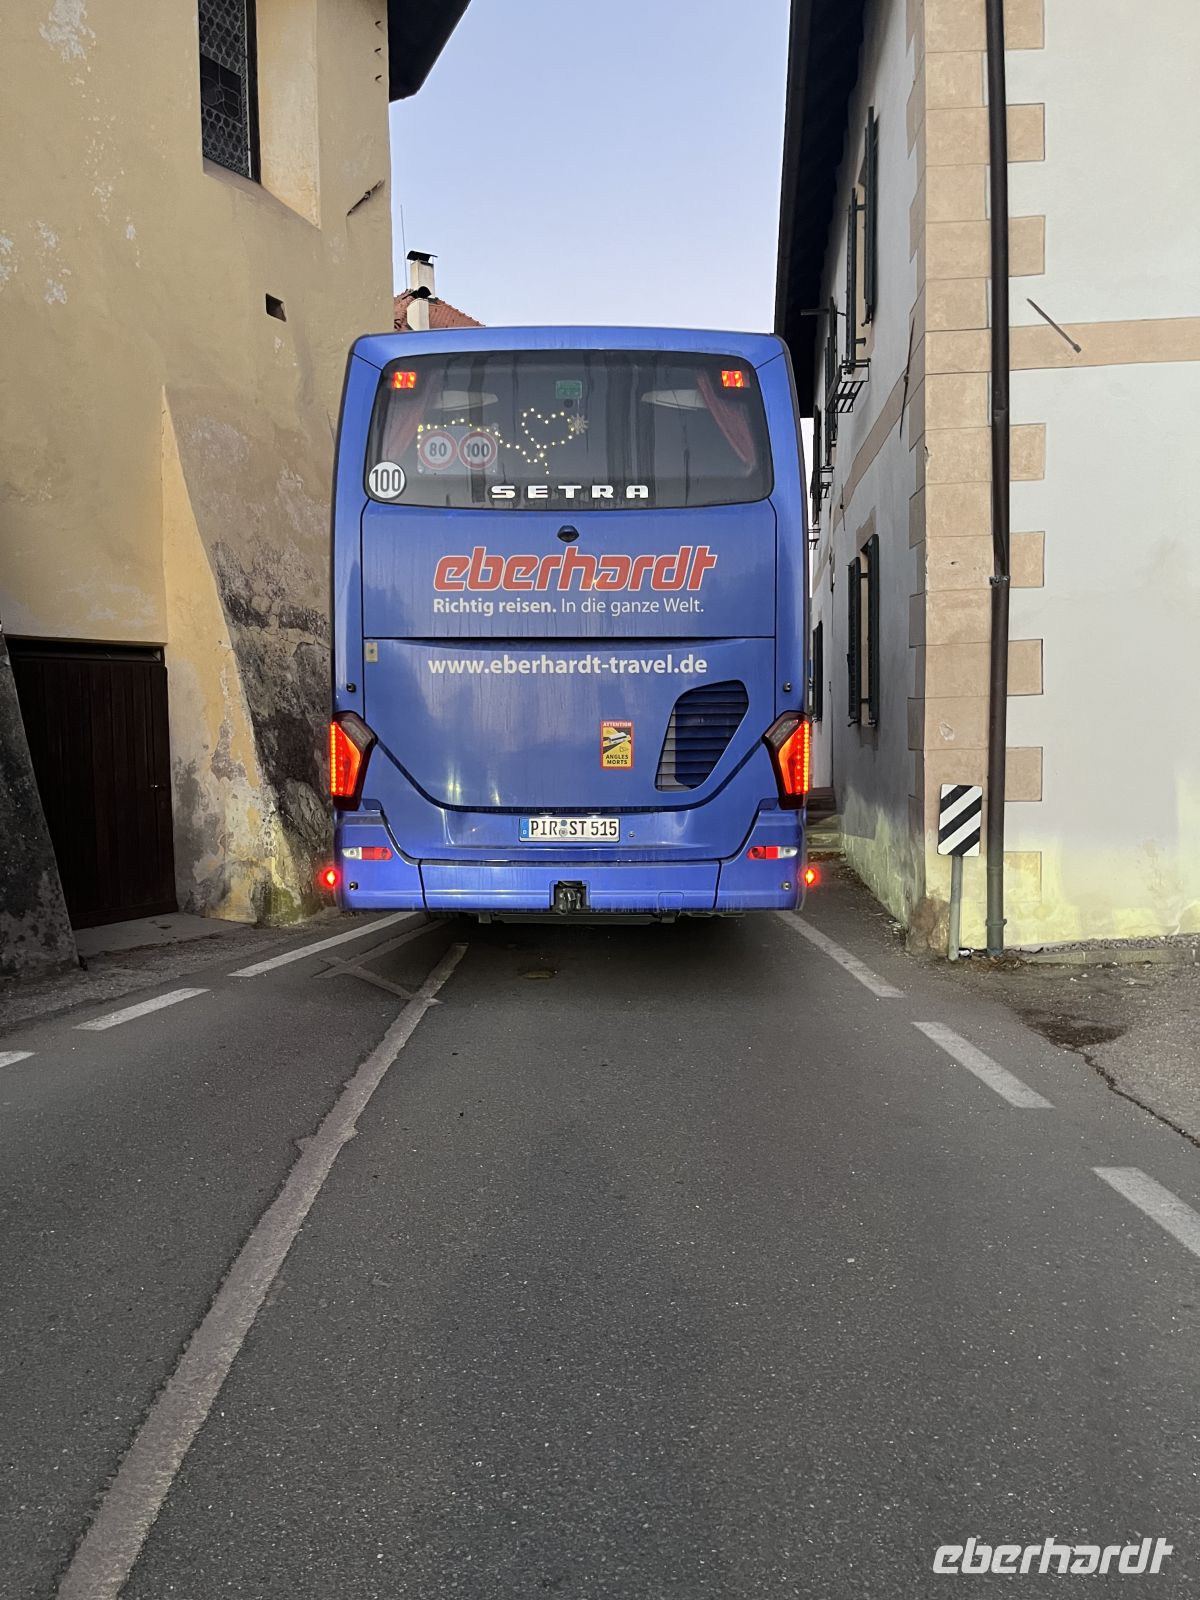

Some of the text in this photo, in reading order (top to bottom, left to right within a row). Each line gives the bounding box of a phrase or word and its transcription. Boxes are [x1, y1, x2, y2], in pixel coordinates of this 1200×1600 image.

[430, 442, 447, 457] 80
[466, 442, 490, 458] 100
[372, 469, 402, 492] 100
[491, 484, 649, 499] SETRA
[433, 545, 718, 592] eberhardt
[433, 597, 705, 617] Richtig reisen. In die ganze Welt.
[428, 654, 708, 675] www.eberhardt-travel.de
[530, 820, 558, 836] PIR
[569, 820, 587, 836] ST
[590, 821, 617, 836] 515
